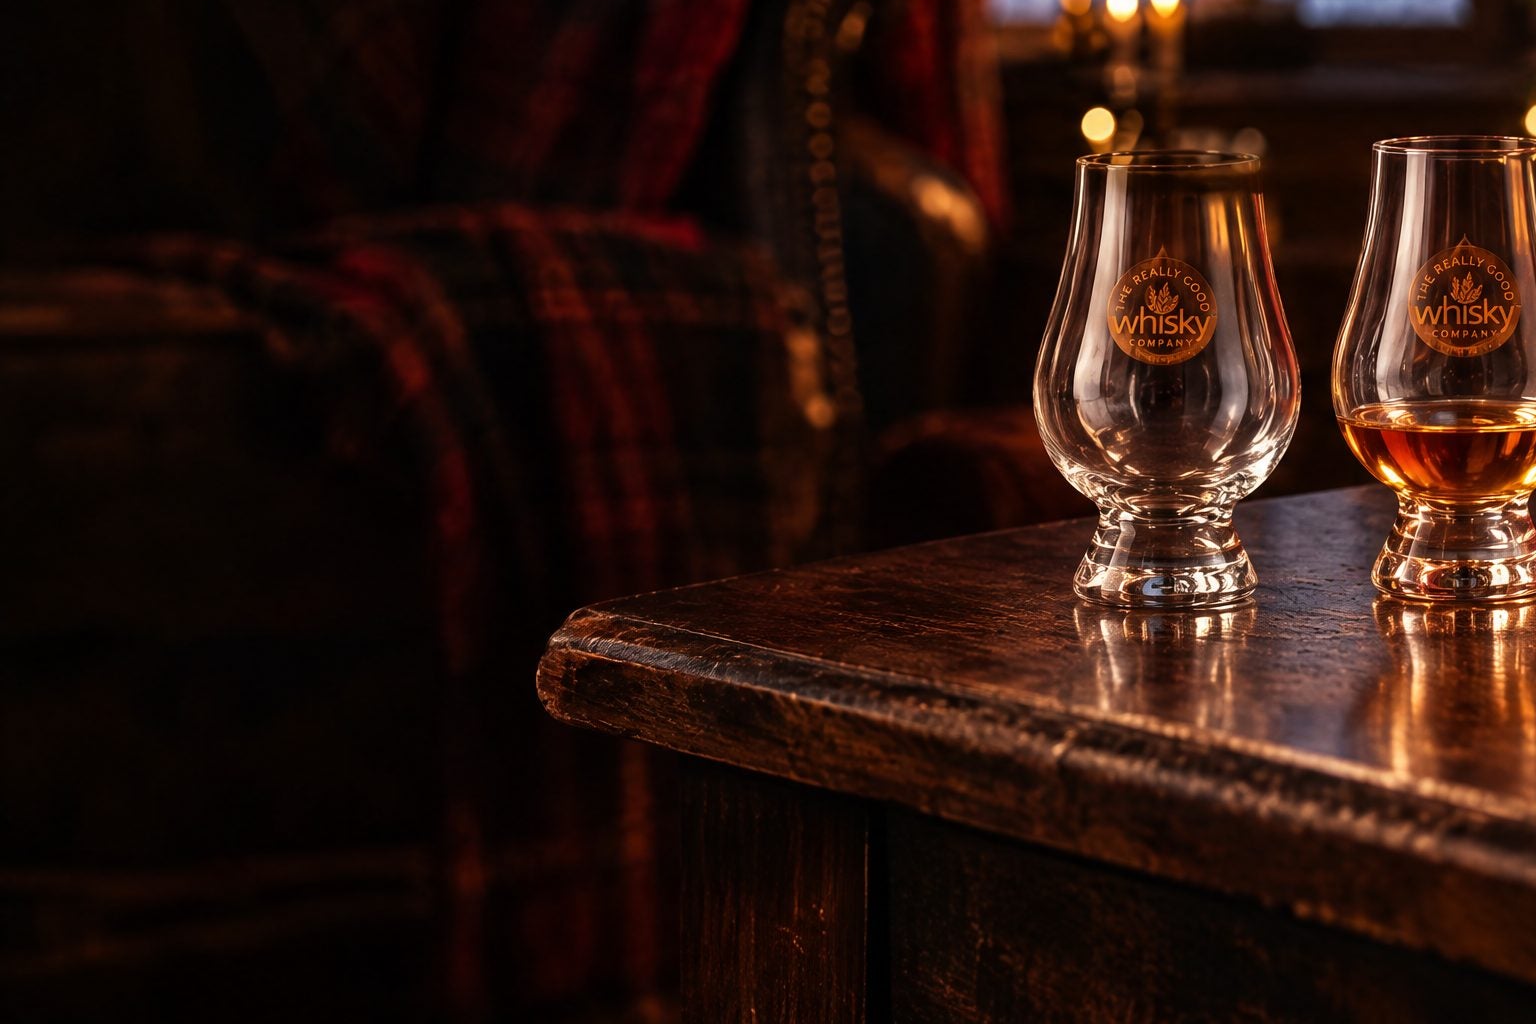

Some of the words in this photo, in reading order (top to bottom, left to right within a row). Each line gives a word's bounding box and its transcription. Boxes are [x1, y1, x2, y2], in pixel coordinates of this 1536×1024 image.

[1132, 266, 1182, 286] REALLY
[1433, 255, 1485, 275] REALLY
[1487, 264, 1514, 301] GOOD
[1112, 305, 1211, 342] whisky
[1414, 295, 1515, 334] whisky
[1128, 338, 1193, 348] COMPANY
[1431, 329, 1498, 339] COMPANY
